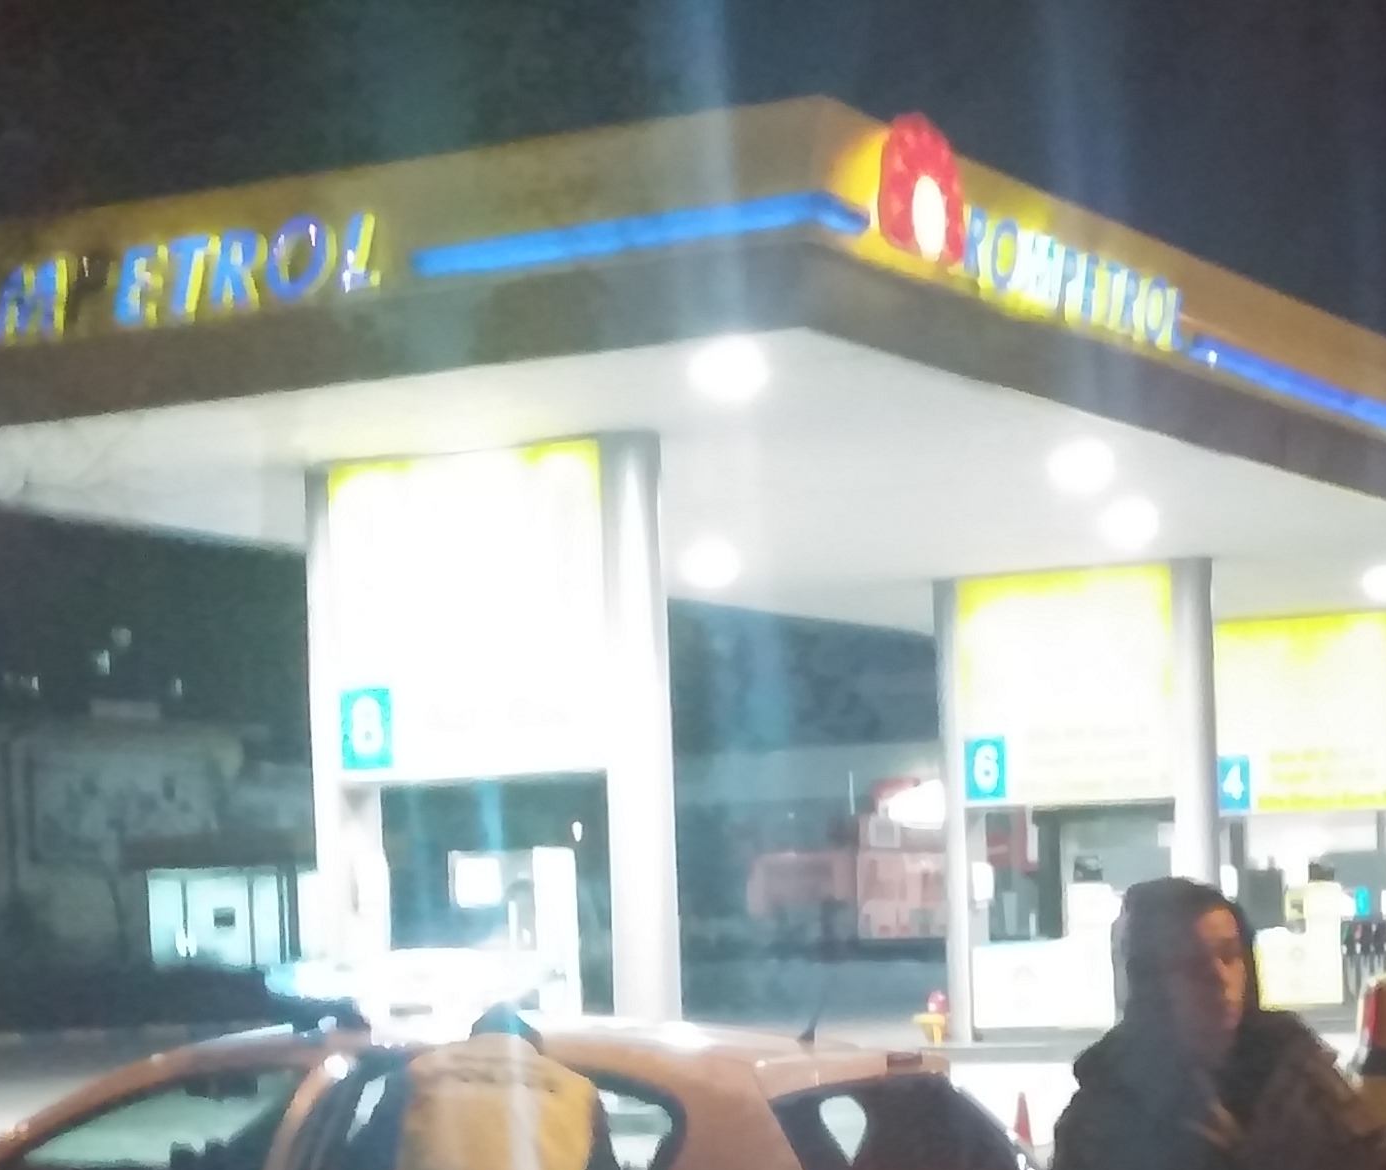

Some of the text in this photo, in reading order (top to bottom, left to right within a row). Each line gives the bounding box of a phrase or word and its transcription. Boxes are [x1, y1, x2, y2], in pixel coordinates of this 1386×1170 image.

[963, 204, 1184, 352] ROMPETROL
[973, 743, 1000, 794] 6
[1222, 763, 1245, 801] 4
